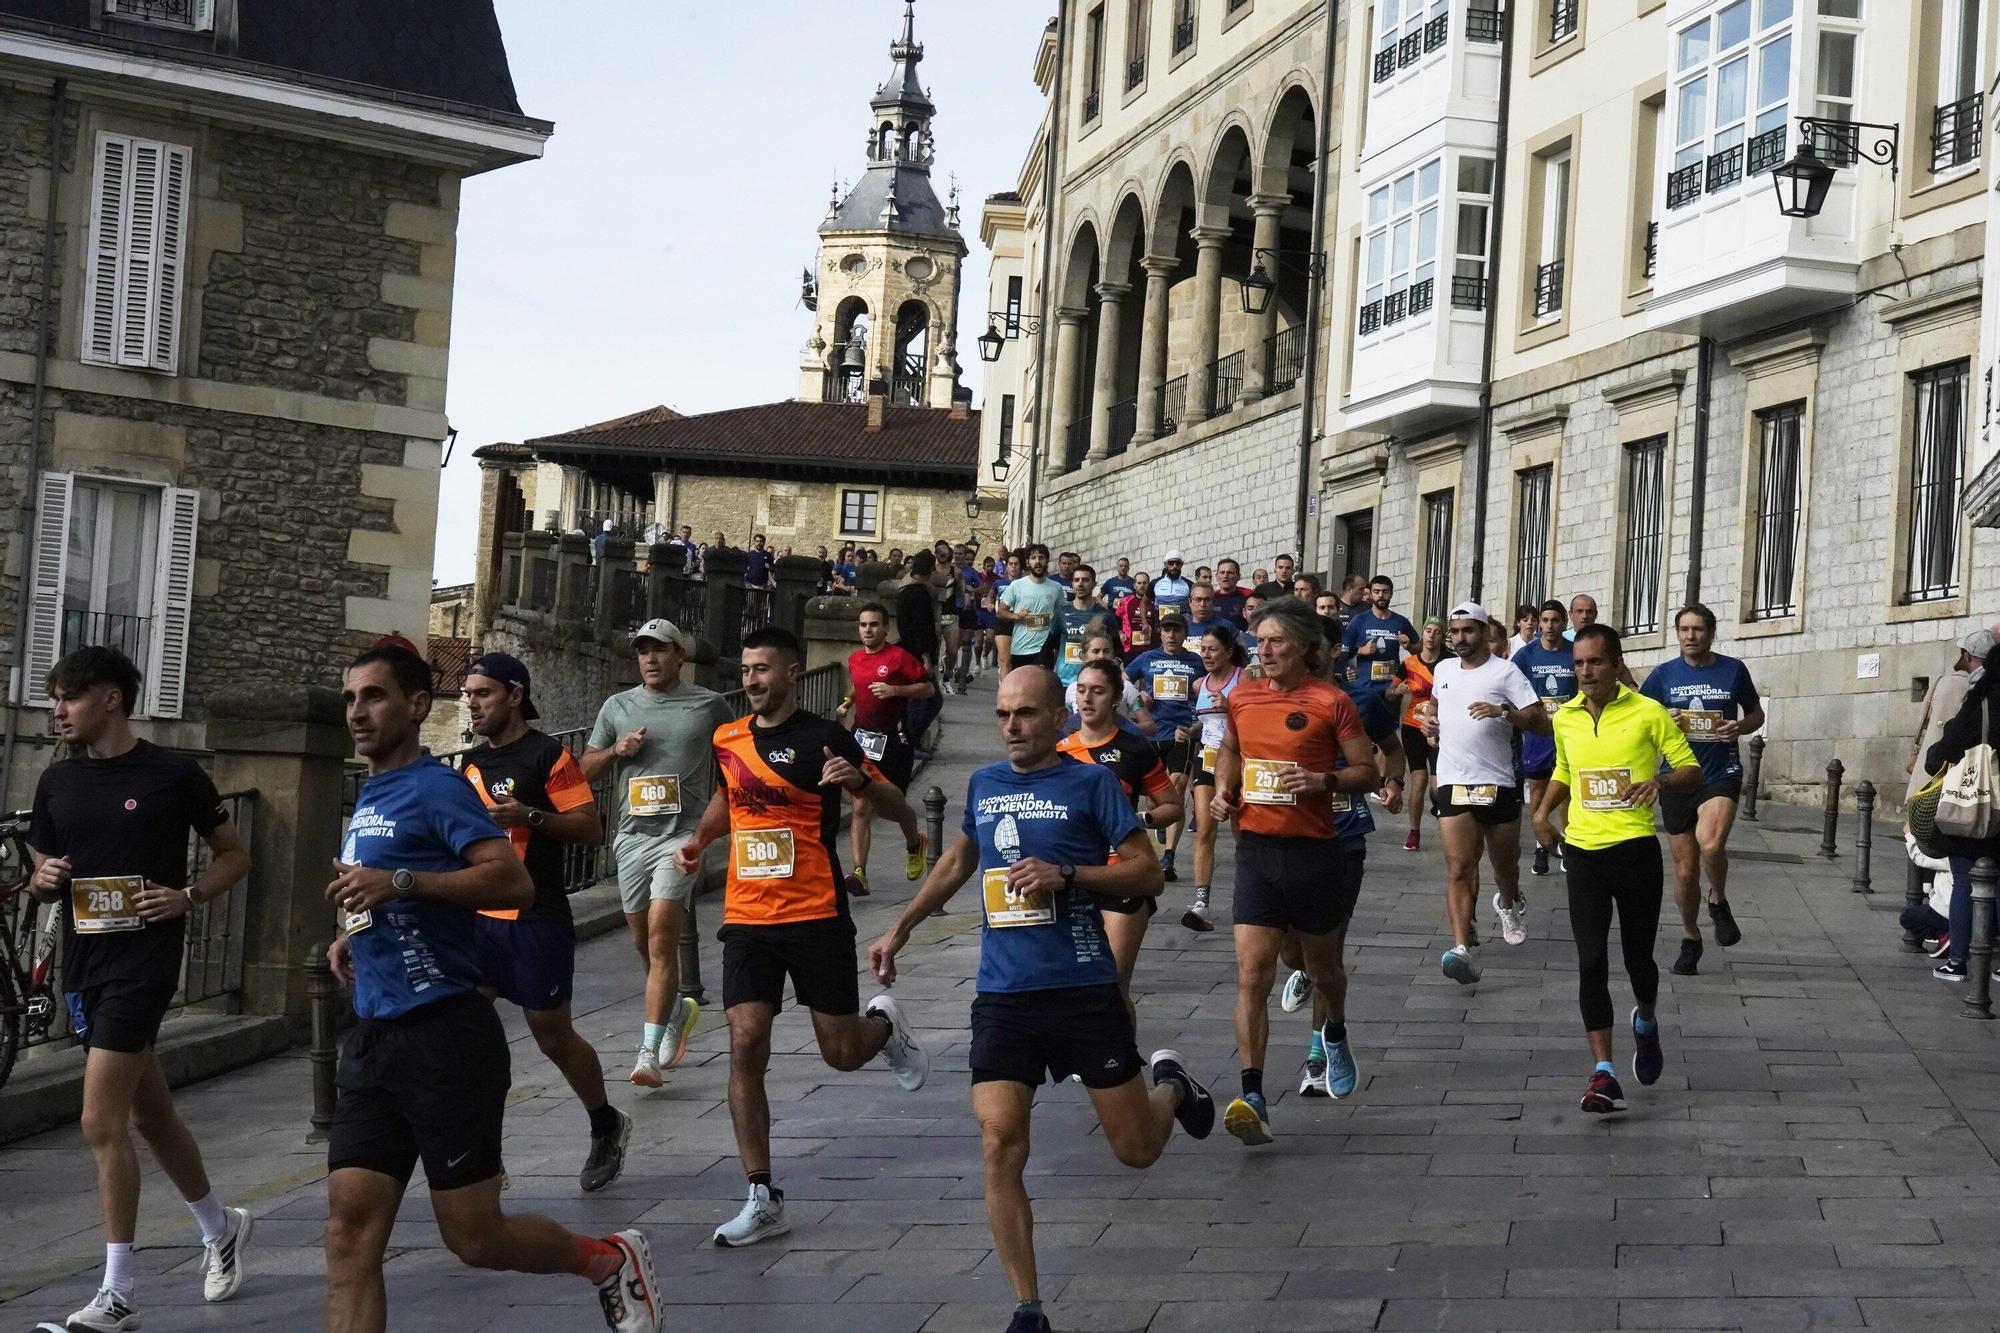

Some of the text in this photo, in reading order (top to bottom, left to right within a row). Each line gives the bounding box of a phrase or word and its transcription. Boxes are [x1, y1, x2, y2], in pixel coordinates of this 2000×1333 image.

[1163, 681, 1180, 691] 397
[1679, 688, 1723, 697] ALMENDRA
[1689, 718, 1712, 730] 550
[1256, 770, 1279, 788] 257
[641, 785, 666, 801] 460
[1589, 779, 1617, 796] 503
[985, 792, 1035, 805] CONQUISTA
[984, 800, 1054, 815] ALMENDRA
[1017, 811, 1068, 820] KONKISTA
[357, 827, 394, 838] KONKISTA
[747, 842, 778, 861] 580
[88, 890, 123, 912] 258
